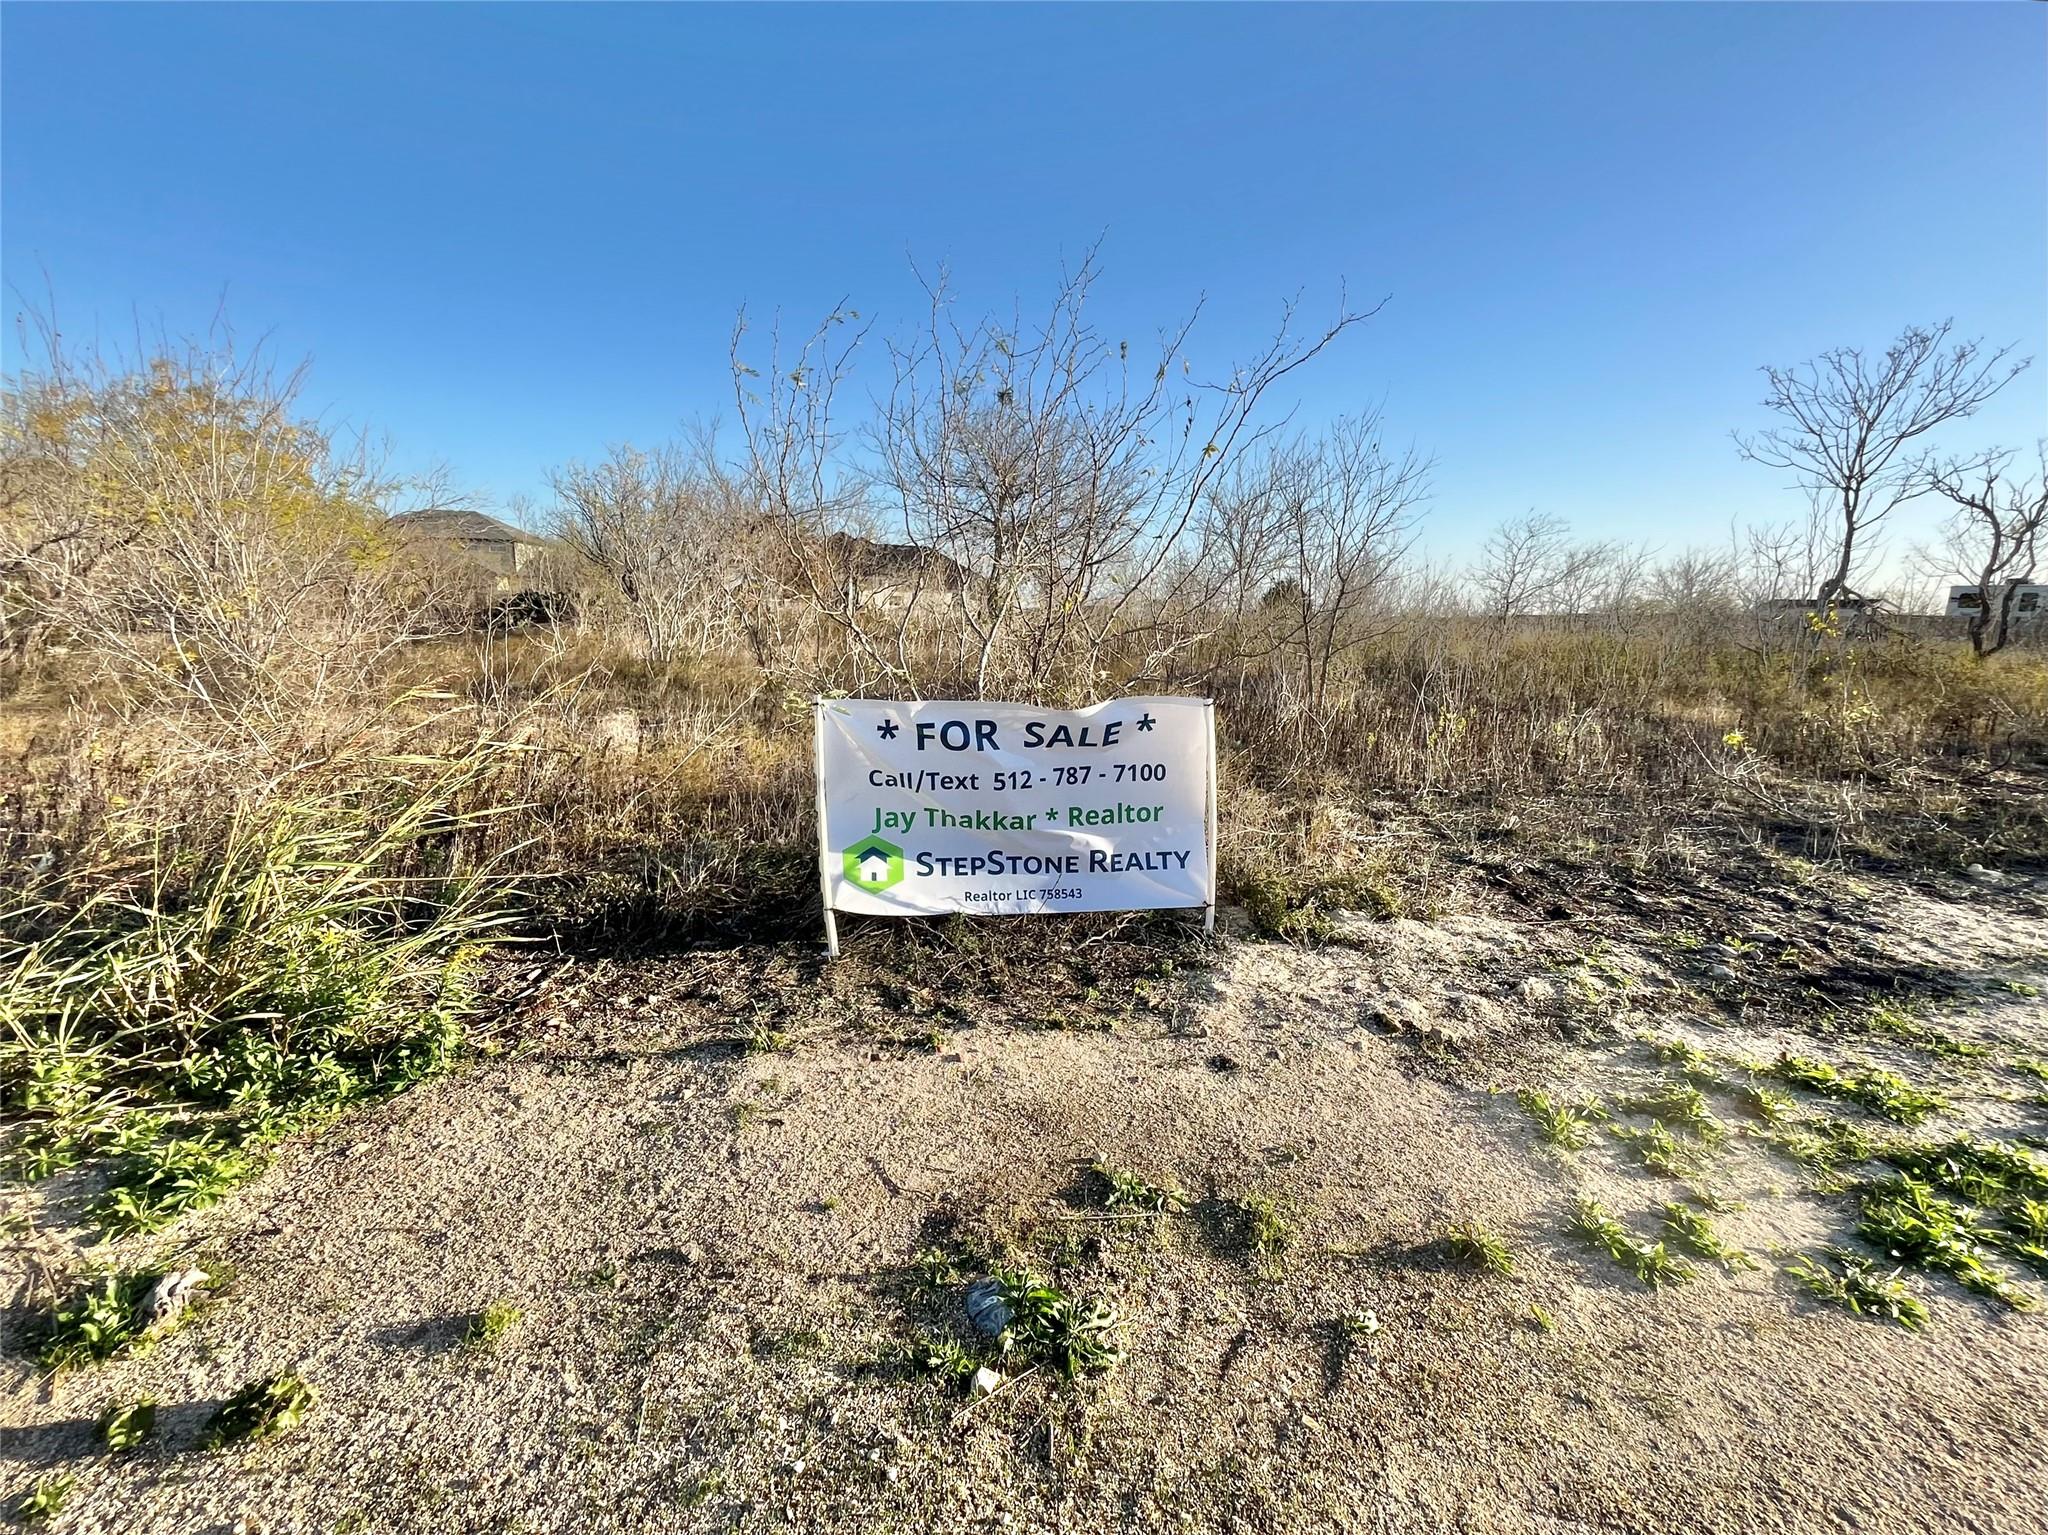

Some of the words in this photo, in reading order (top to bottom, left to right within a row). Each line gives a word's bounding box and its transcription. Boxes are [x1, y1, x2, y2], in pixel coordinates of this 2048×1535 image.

[915, 719, 1001, 752] FOR
[1023, 720, 1123, 749] SALE
[868, 769, 980, 794] Call/Text
[993, 770, 1033, 792] 512
[1052, 765, 1092, 787] 787
[1113, 763, 1167, 783] 7100
[871, 807, 917, 835] Jay
[923, 807, 1037, 831] Thakkar
[1068, 802, 1164, 828] Realtor
[964, 889, 1013, 902] Realtor
[1016, 889, 1037, 901] LIC
[1038, 887, 1084, 902] 758543
